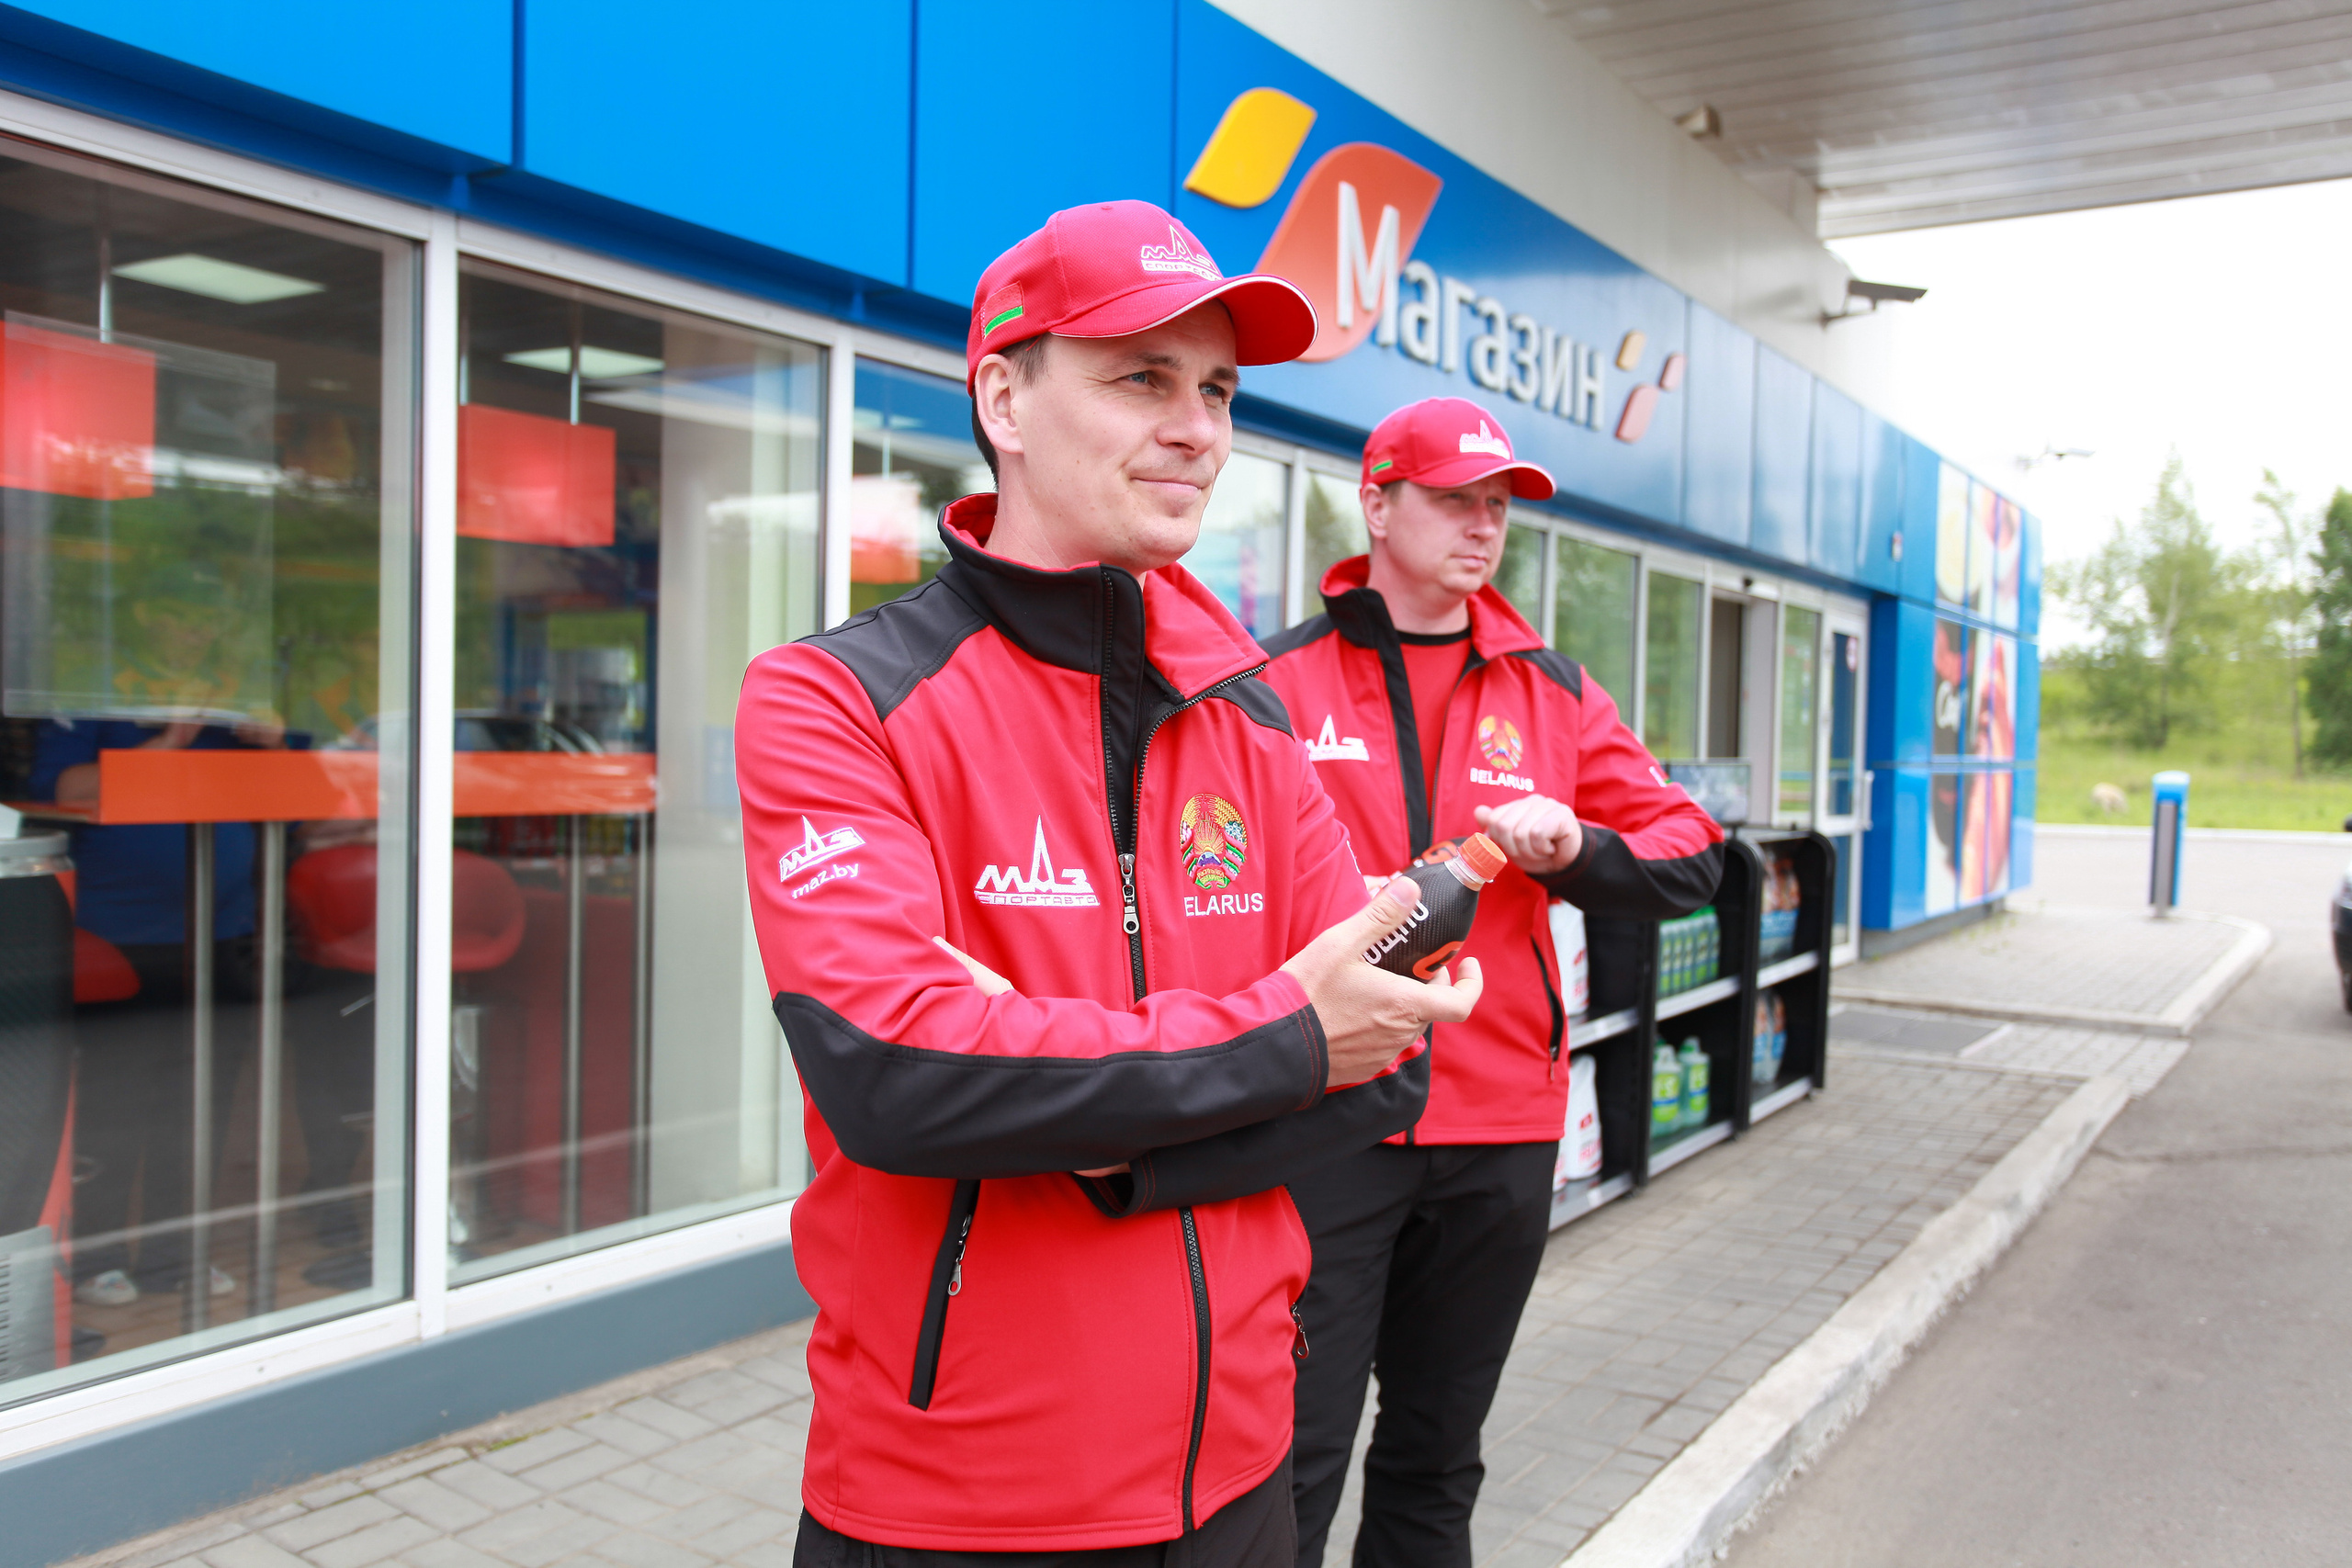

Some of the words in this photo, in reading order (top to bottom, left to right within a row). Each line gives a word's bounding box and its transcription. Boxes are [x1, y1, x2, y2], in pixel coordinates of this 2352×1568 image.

[1337, 181, 1604, 431] Магазин
[1470, 767, 1534, 792] BELARUS
[792, 863, 859, 899] maz.by
[975, 893, 1098, 906] СПОРТАВТО
[1184, 893, 1264, 917] ELARUS
